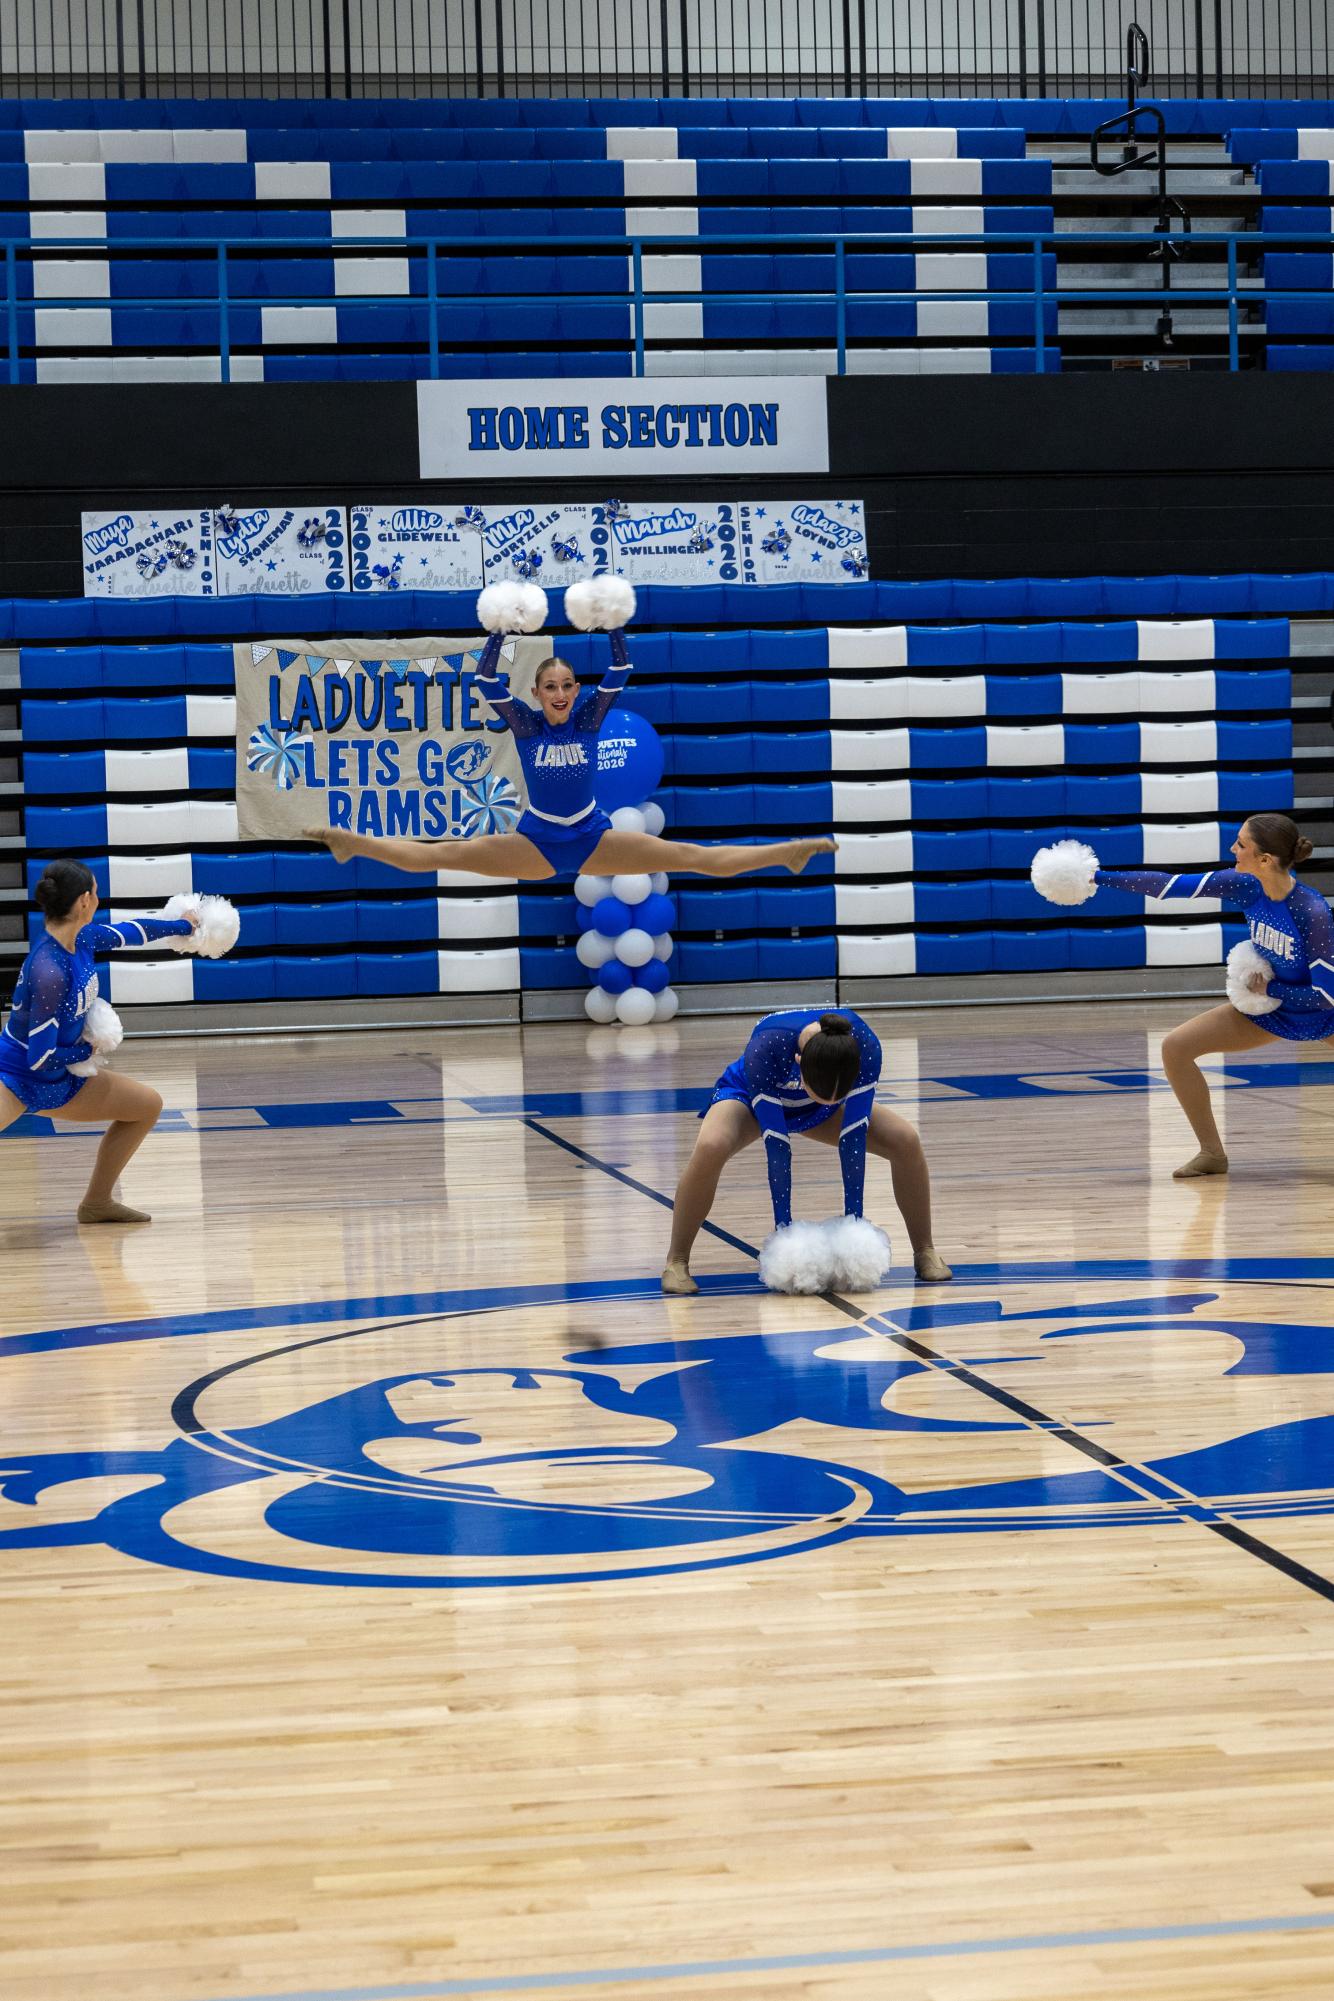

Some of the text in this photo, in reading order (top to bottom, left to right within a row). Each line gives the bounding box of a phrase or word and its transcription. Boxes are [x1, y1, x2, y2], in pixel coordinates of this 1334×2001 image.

[467, 403, 779, 450] HOME SECTION
[85, 519, 193, 573] VARADACHARI
[217, 509, 270, 559] Lydia
[239, 511, 295, 567] STONEMAN
[325, 509, 345, 590] 2026
[377, 532, 461, 542] GLIDEWELL
[484, 508, 535, 549] Mia
[484, 510, 561, 568] GOURTZELIS
[612, 508, 696, 545] Marah
[620, 545, 705, 556] SWILLINGER
[717, 505, 738, 580] 2026
[740, 506, 757, 583] SENIOR
[794, 525, 836, 550] LOYND
[200, 511, 213, 594] SENIOR
[352, 513, 373, 590] 2026
[303, 738, 401, 788] LETS
[534, 743, 588, 767] LADUE
[597, 758, 625, 770] 2026
[327, 789, 464, 838] RAMS!
[1250, 919, 1295, 960] LADUE
